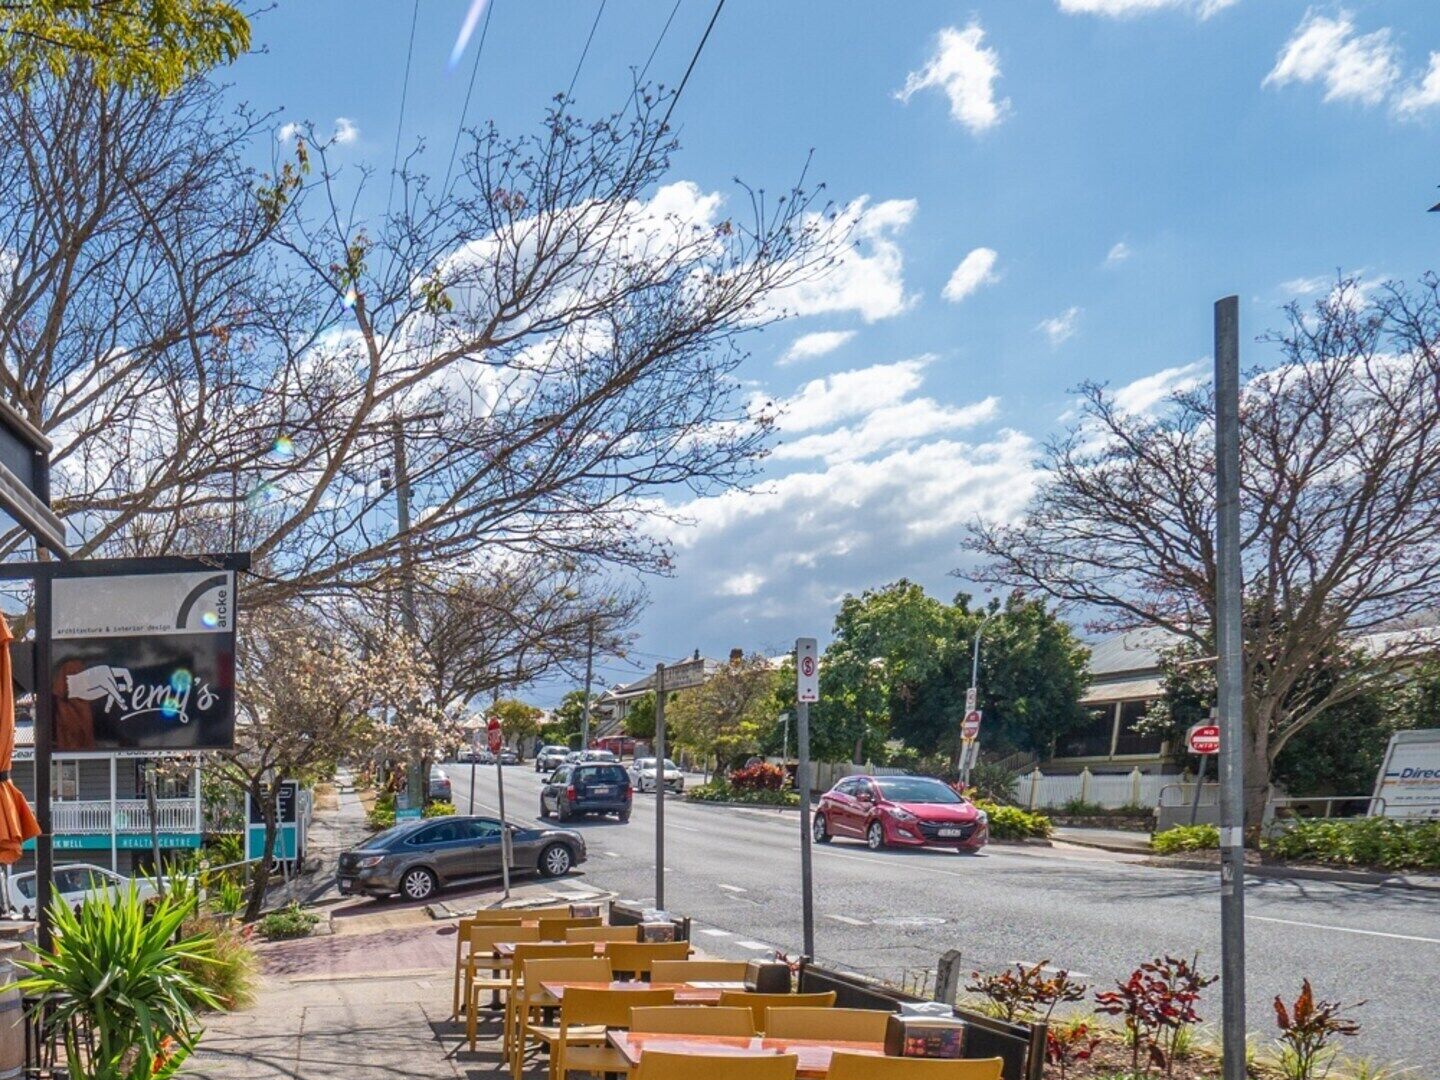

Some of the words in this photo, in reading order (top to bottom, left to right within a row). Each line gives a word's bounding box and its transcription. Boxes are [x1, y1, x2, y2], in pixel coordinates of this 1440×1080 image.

[215, 589, 228, 629] arcke
[57, 626, 103, 635] architecture
[113, 625, 144, 633] interior
[147, 624, 171, 632] design
[62, 839, 84, 848] WELL
[122, 839, 153, 848] HEALTH
[158, 838, 192, 847] CENTRE
